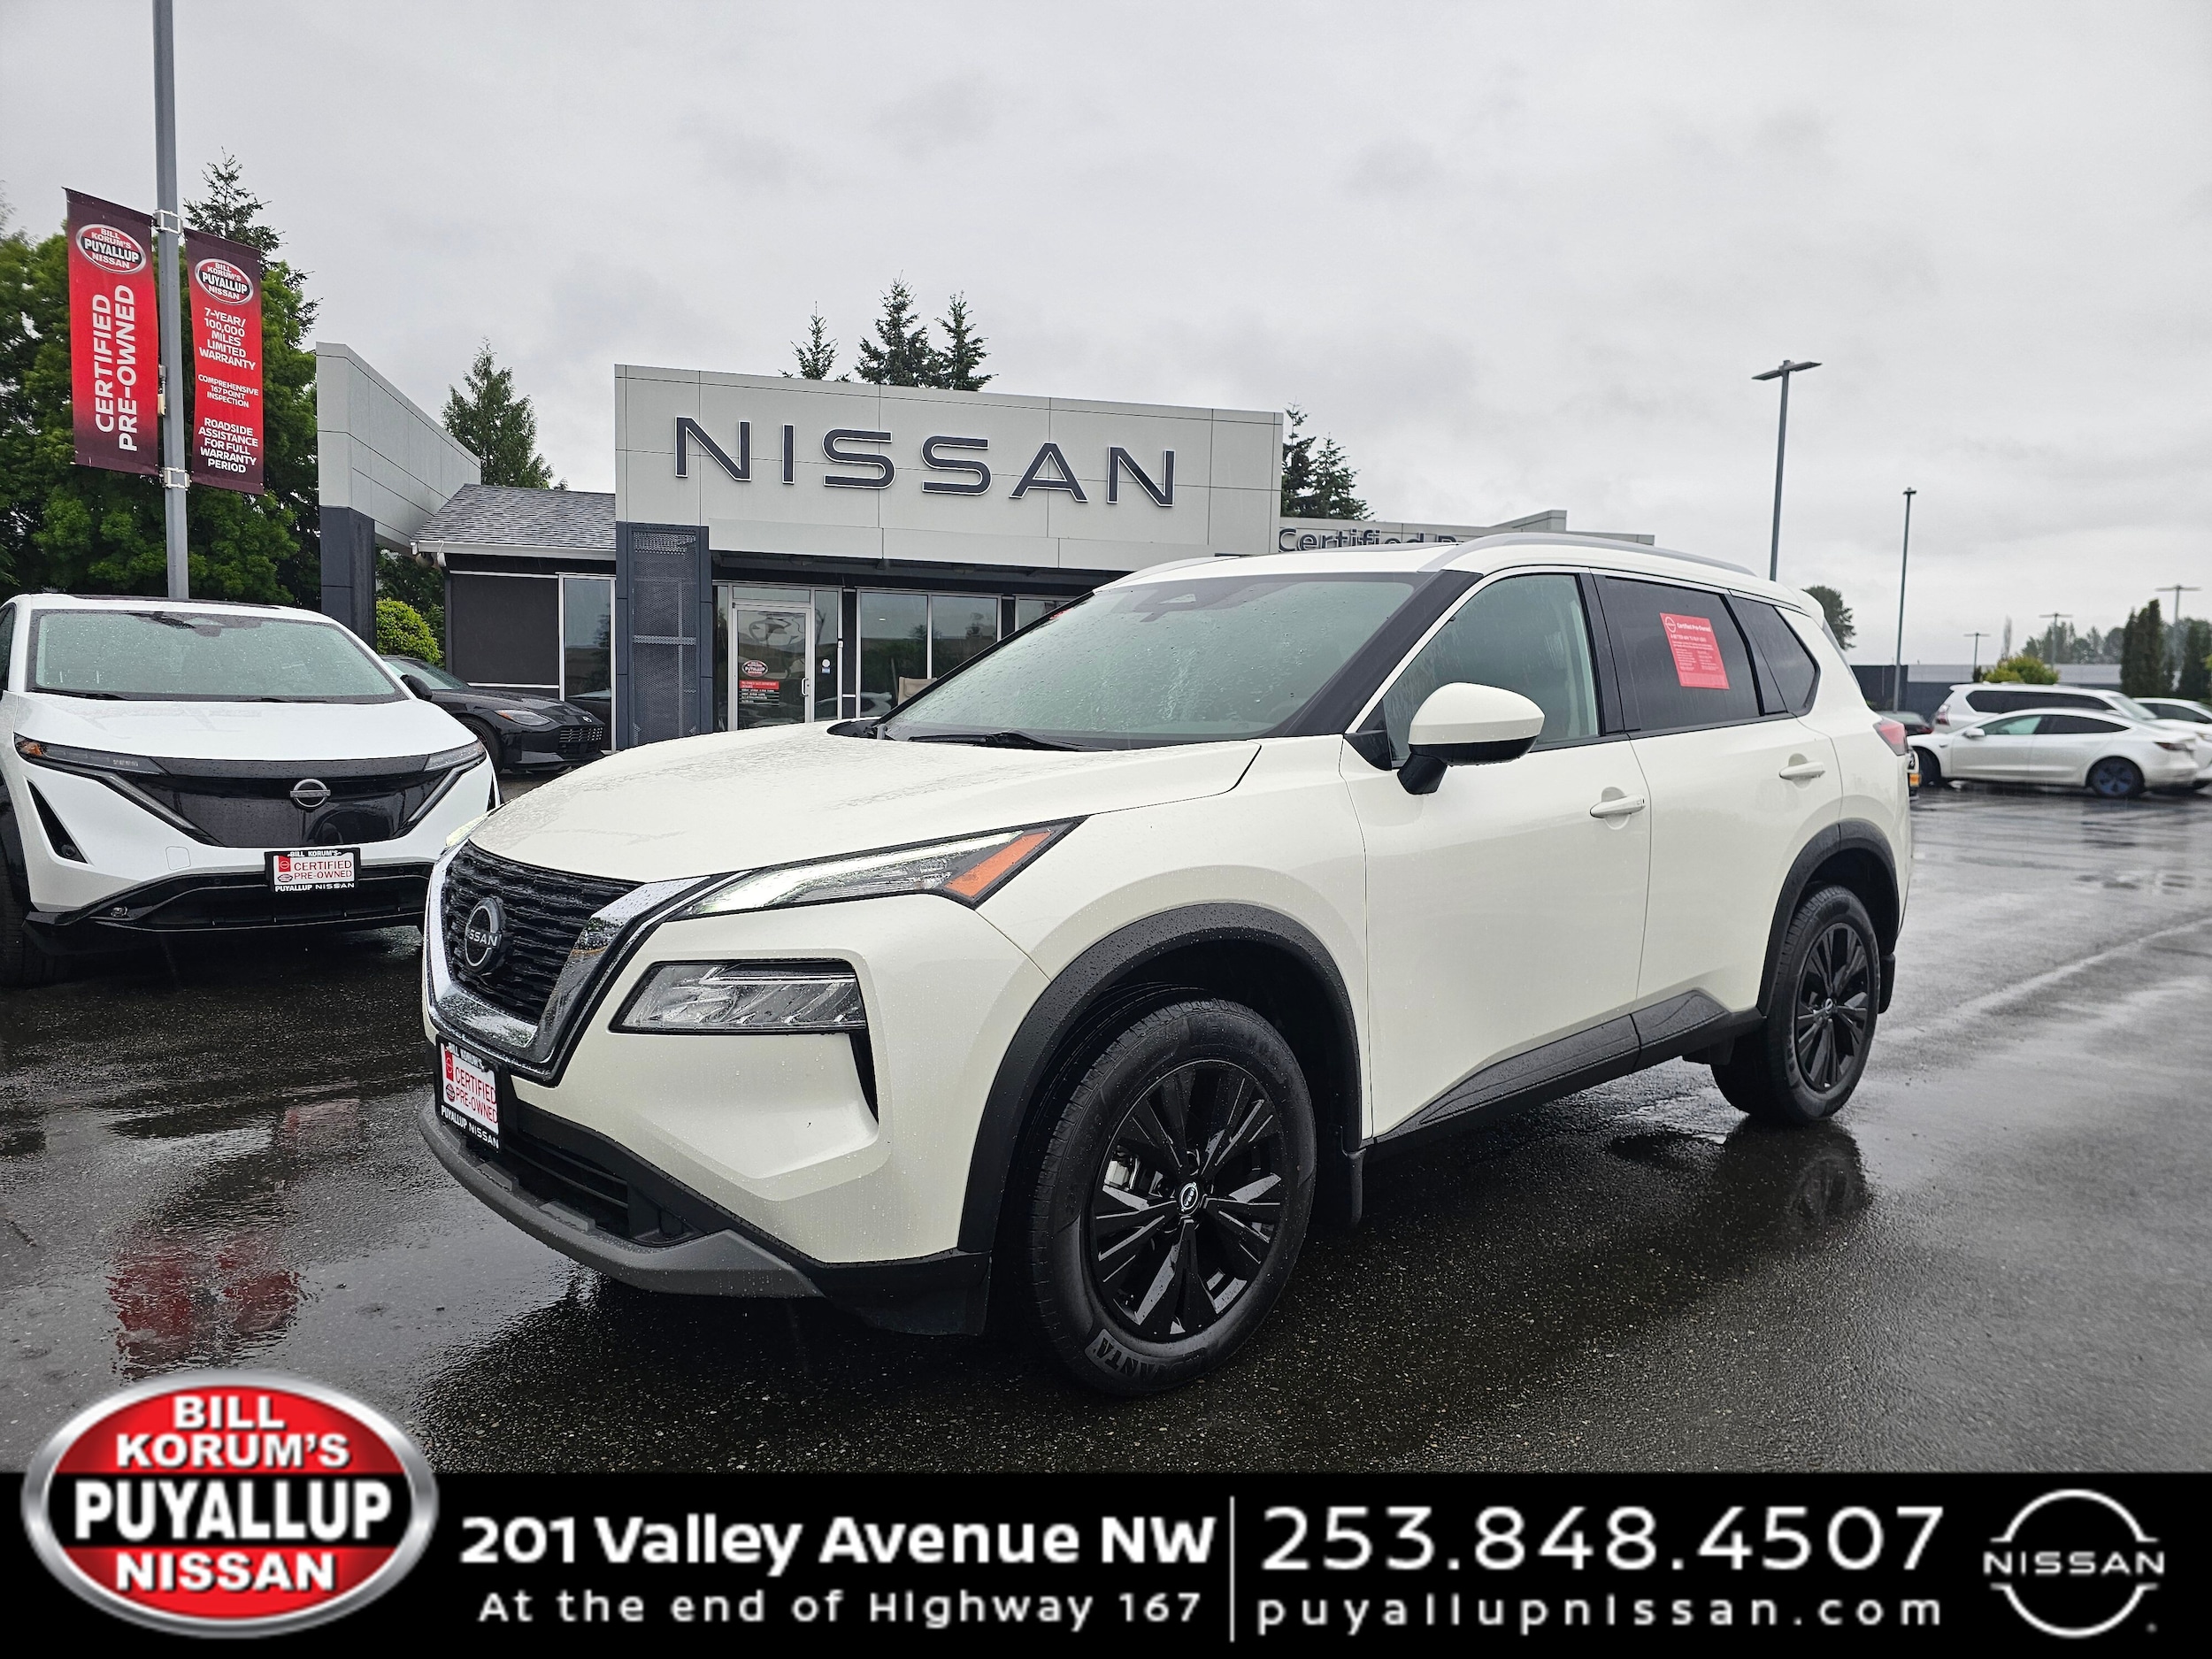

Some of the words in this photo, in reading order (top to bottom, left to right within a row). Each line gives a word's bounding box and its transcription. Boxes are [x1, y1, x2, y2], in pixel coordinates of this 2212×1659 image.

[91, 232, 132, 249] KORUM'S
[101, 227, 121, 240] BILL
[84, 238, 139, 262] PUYALLUP
[92, 252, 130, 269] NISSAN
[215, 263, 232, 273] BILL
[202, 272, 248, 294] PUYALLUP
[207, 266, 242, 281] KORUM'S
[208, 285, 240, 300] NISSAN
[204, 307, 246, 327] 7-YEAR/
[204, 318, 245, 337] 100,000
[211, 330, 242, 347] MILES
[207, 339, 247, 358] LIMITED
[92, 294, 114, 433] CERTIFIED
[115, 284, 138, 451] PRE-OWNED
[199, 347, 256, 371] WARRANTY
[197, 374, 259, 396] COMPREHENSIVE
[211, 385, 222, 394] 167
[222, 389, 246, 400] POINT
[206, 391, 250, 408] INSPECTION
[198, 426, 258, 447] ASSISTANCE
[204, 417, 253, 437] ROADSIDE
[200, 446, 257, 466] WARRANTY
[204, 437, 225, 450] FOR
[226, 442, 251, 456] FULL
[208, 458, 247, 473] PERIOD
[674, 415, 1176, 508] NISSAN
[294, 860, 352, 872] CERTIFIED
[294, 870, 353, 880] PRE-OWNED
[455, 1066, 496, 1105] CERTIFIED
[456, 1087, 498, 1124] PRE-OWNED
[441, 1105, 468, 1130] PUYALLUP
[469, 1122, 499, 1149] NISSAN
